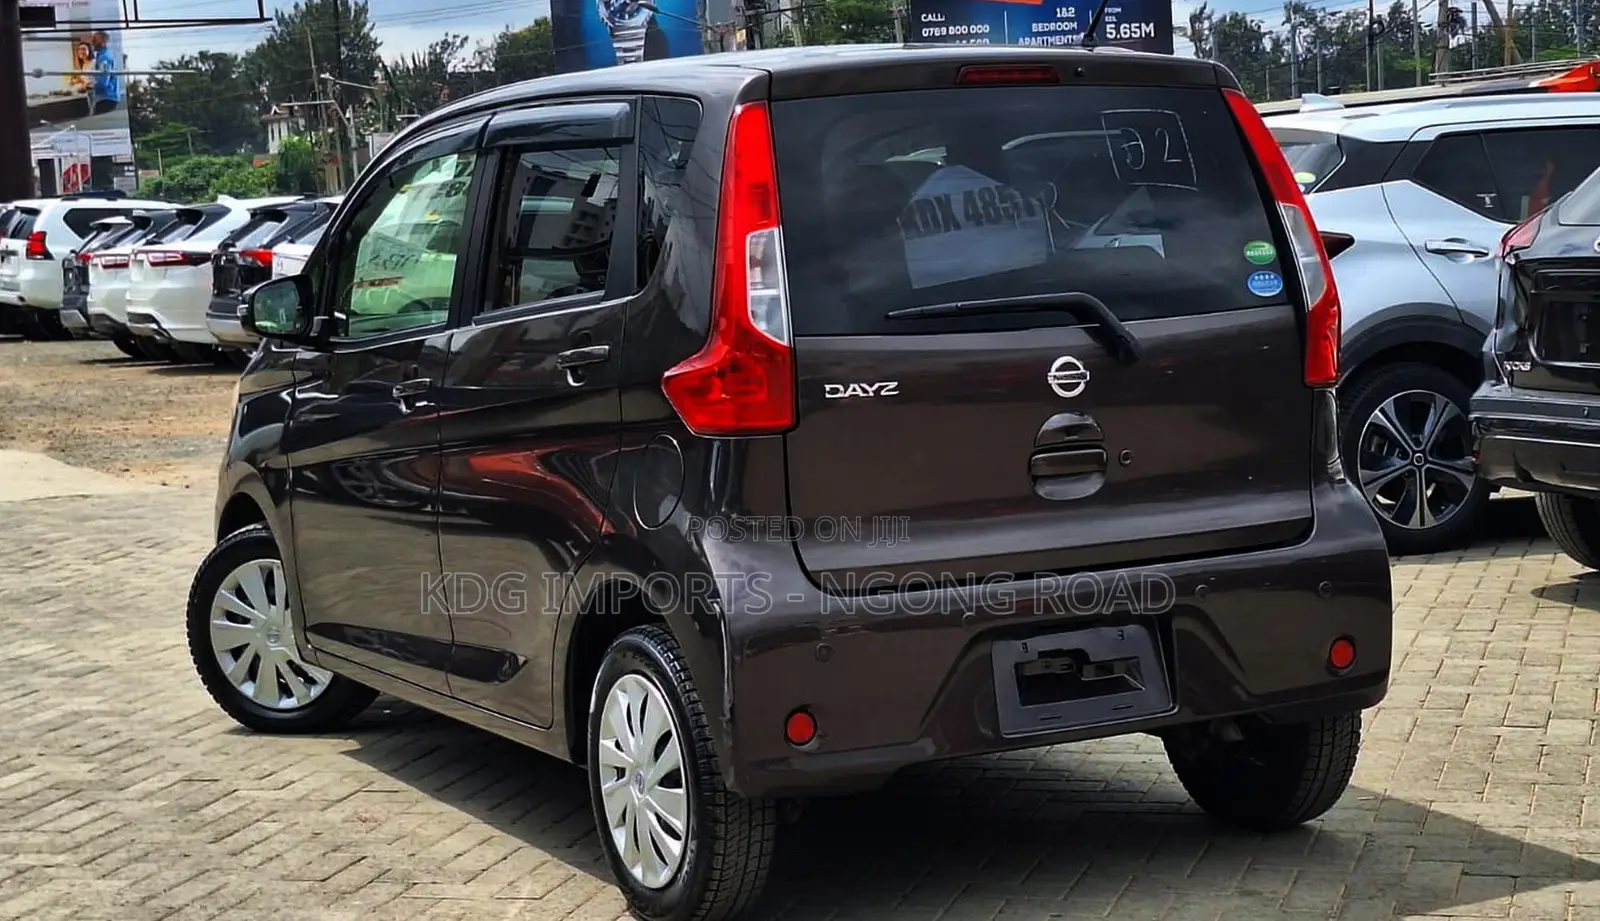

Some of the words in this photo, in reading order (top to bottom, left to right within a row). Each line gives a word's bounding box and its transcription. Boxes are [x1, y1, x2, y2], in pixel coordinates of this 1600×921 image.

[970, 24, 990, 34] 000
[1032, 22, 1078, 32] BEDROOM
[1106, 22, 1155, 39] 5.65M
[824, 381, 900, 398] DAYZ
